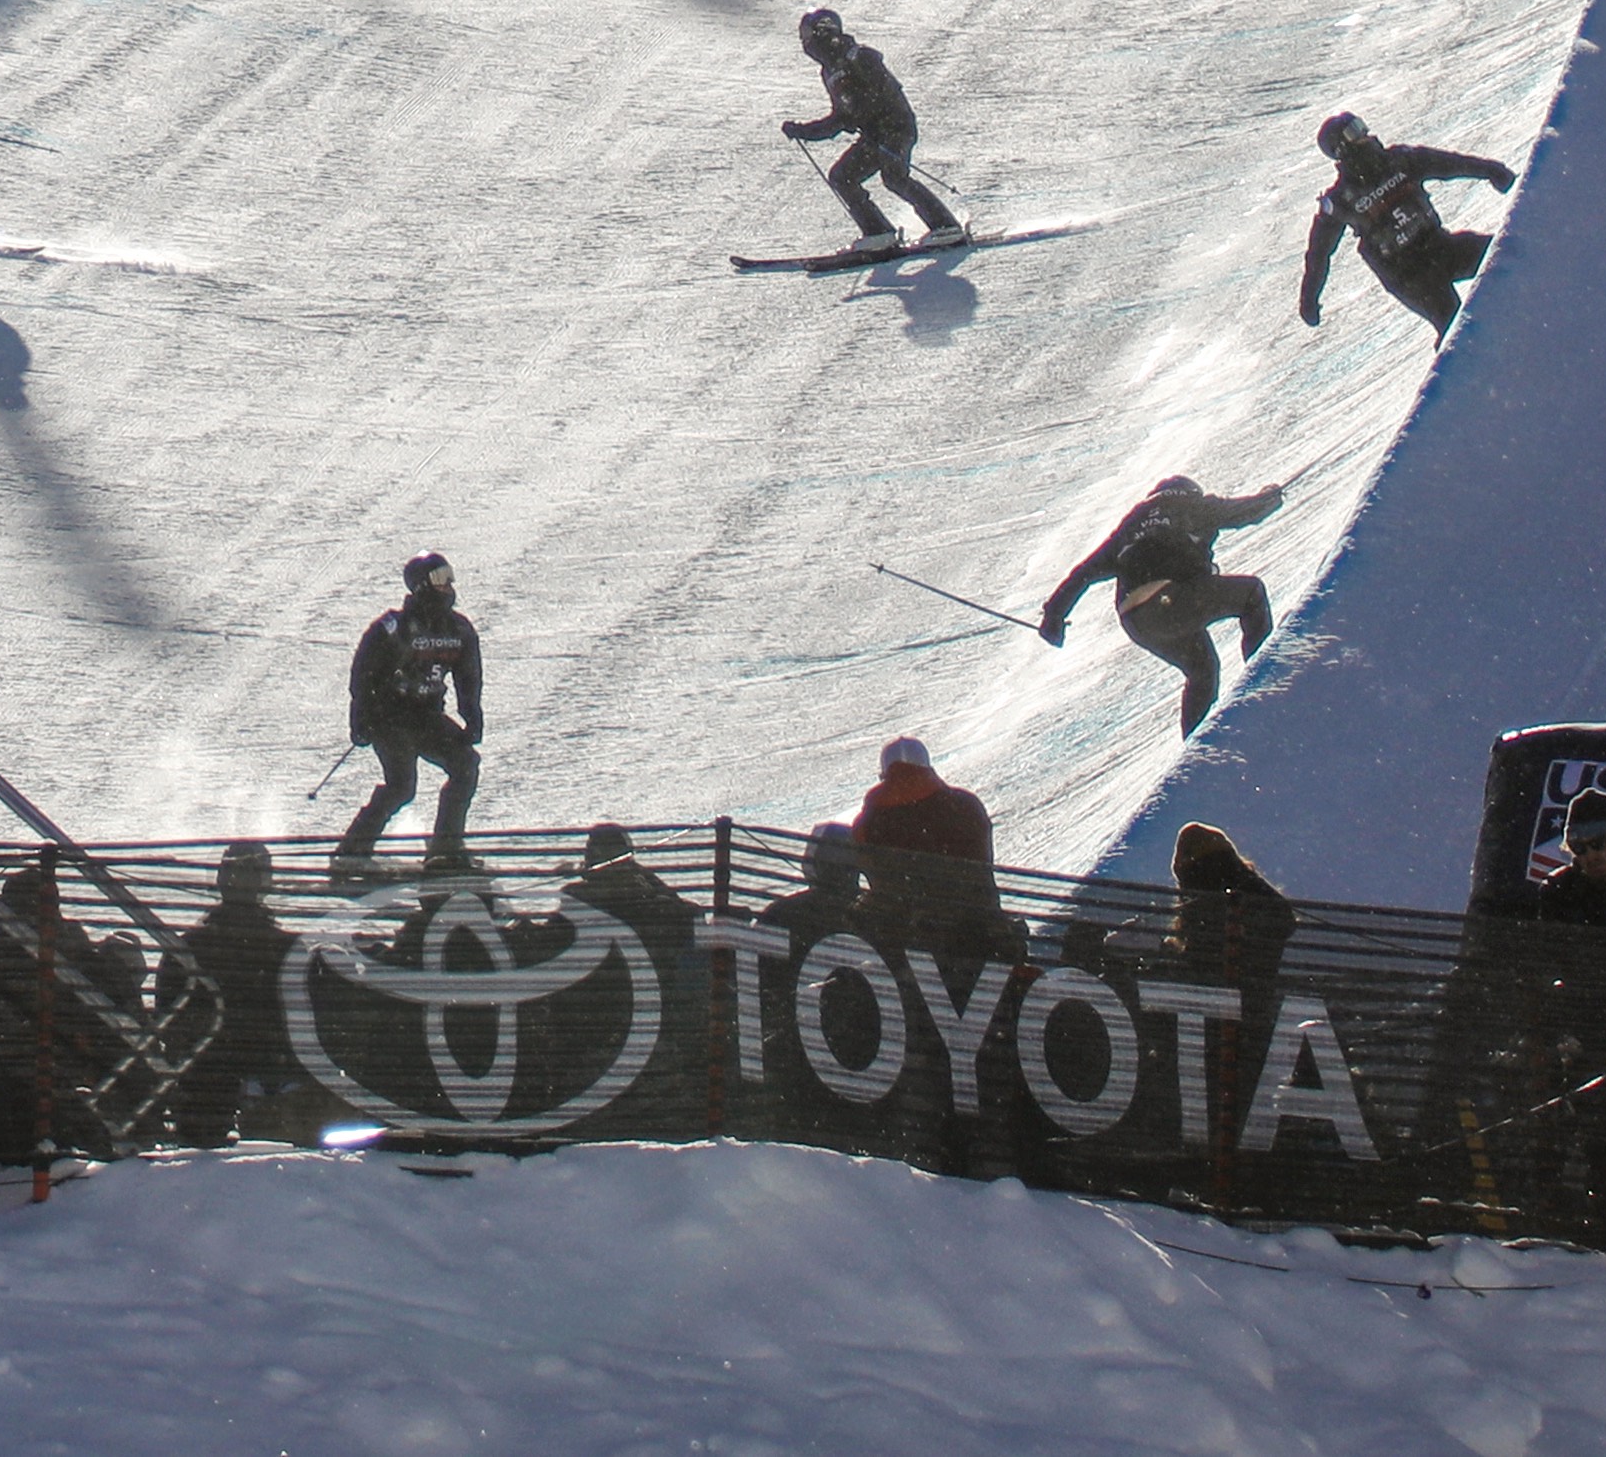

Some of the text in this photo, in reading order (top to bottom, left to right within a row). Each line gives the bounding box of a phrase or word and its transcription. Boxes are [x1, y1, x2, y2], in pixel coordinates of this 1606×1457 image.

[1369, 172, 1407, 199] TOYOTA
[431, 664, 441, 679] 5
[694, 912, 1382, 1161] TOYOTA
